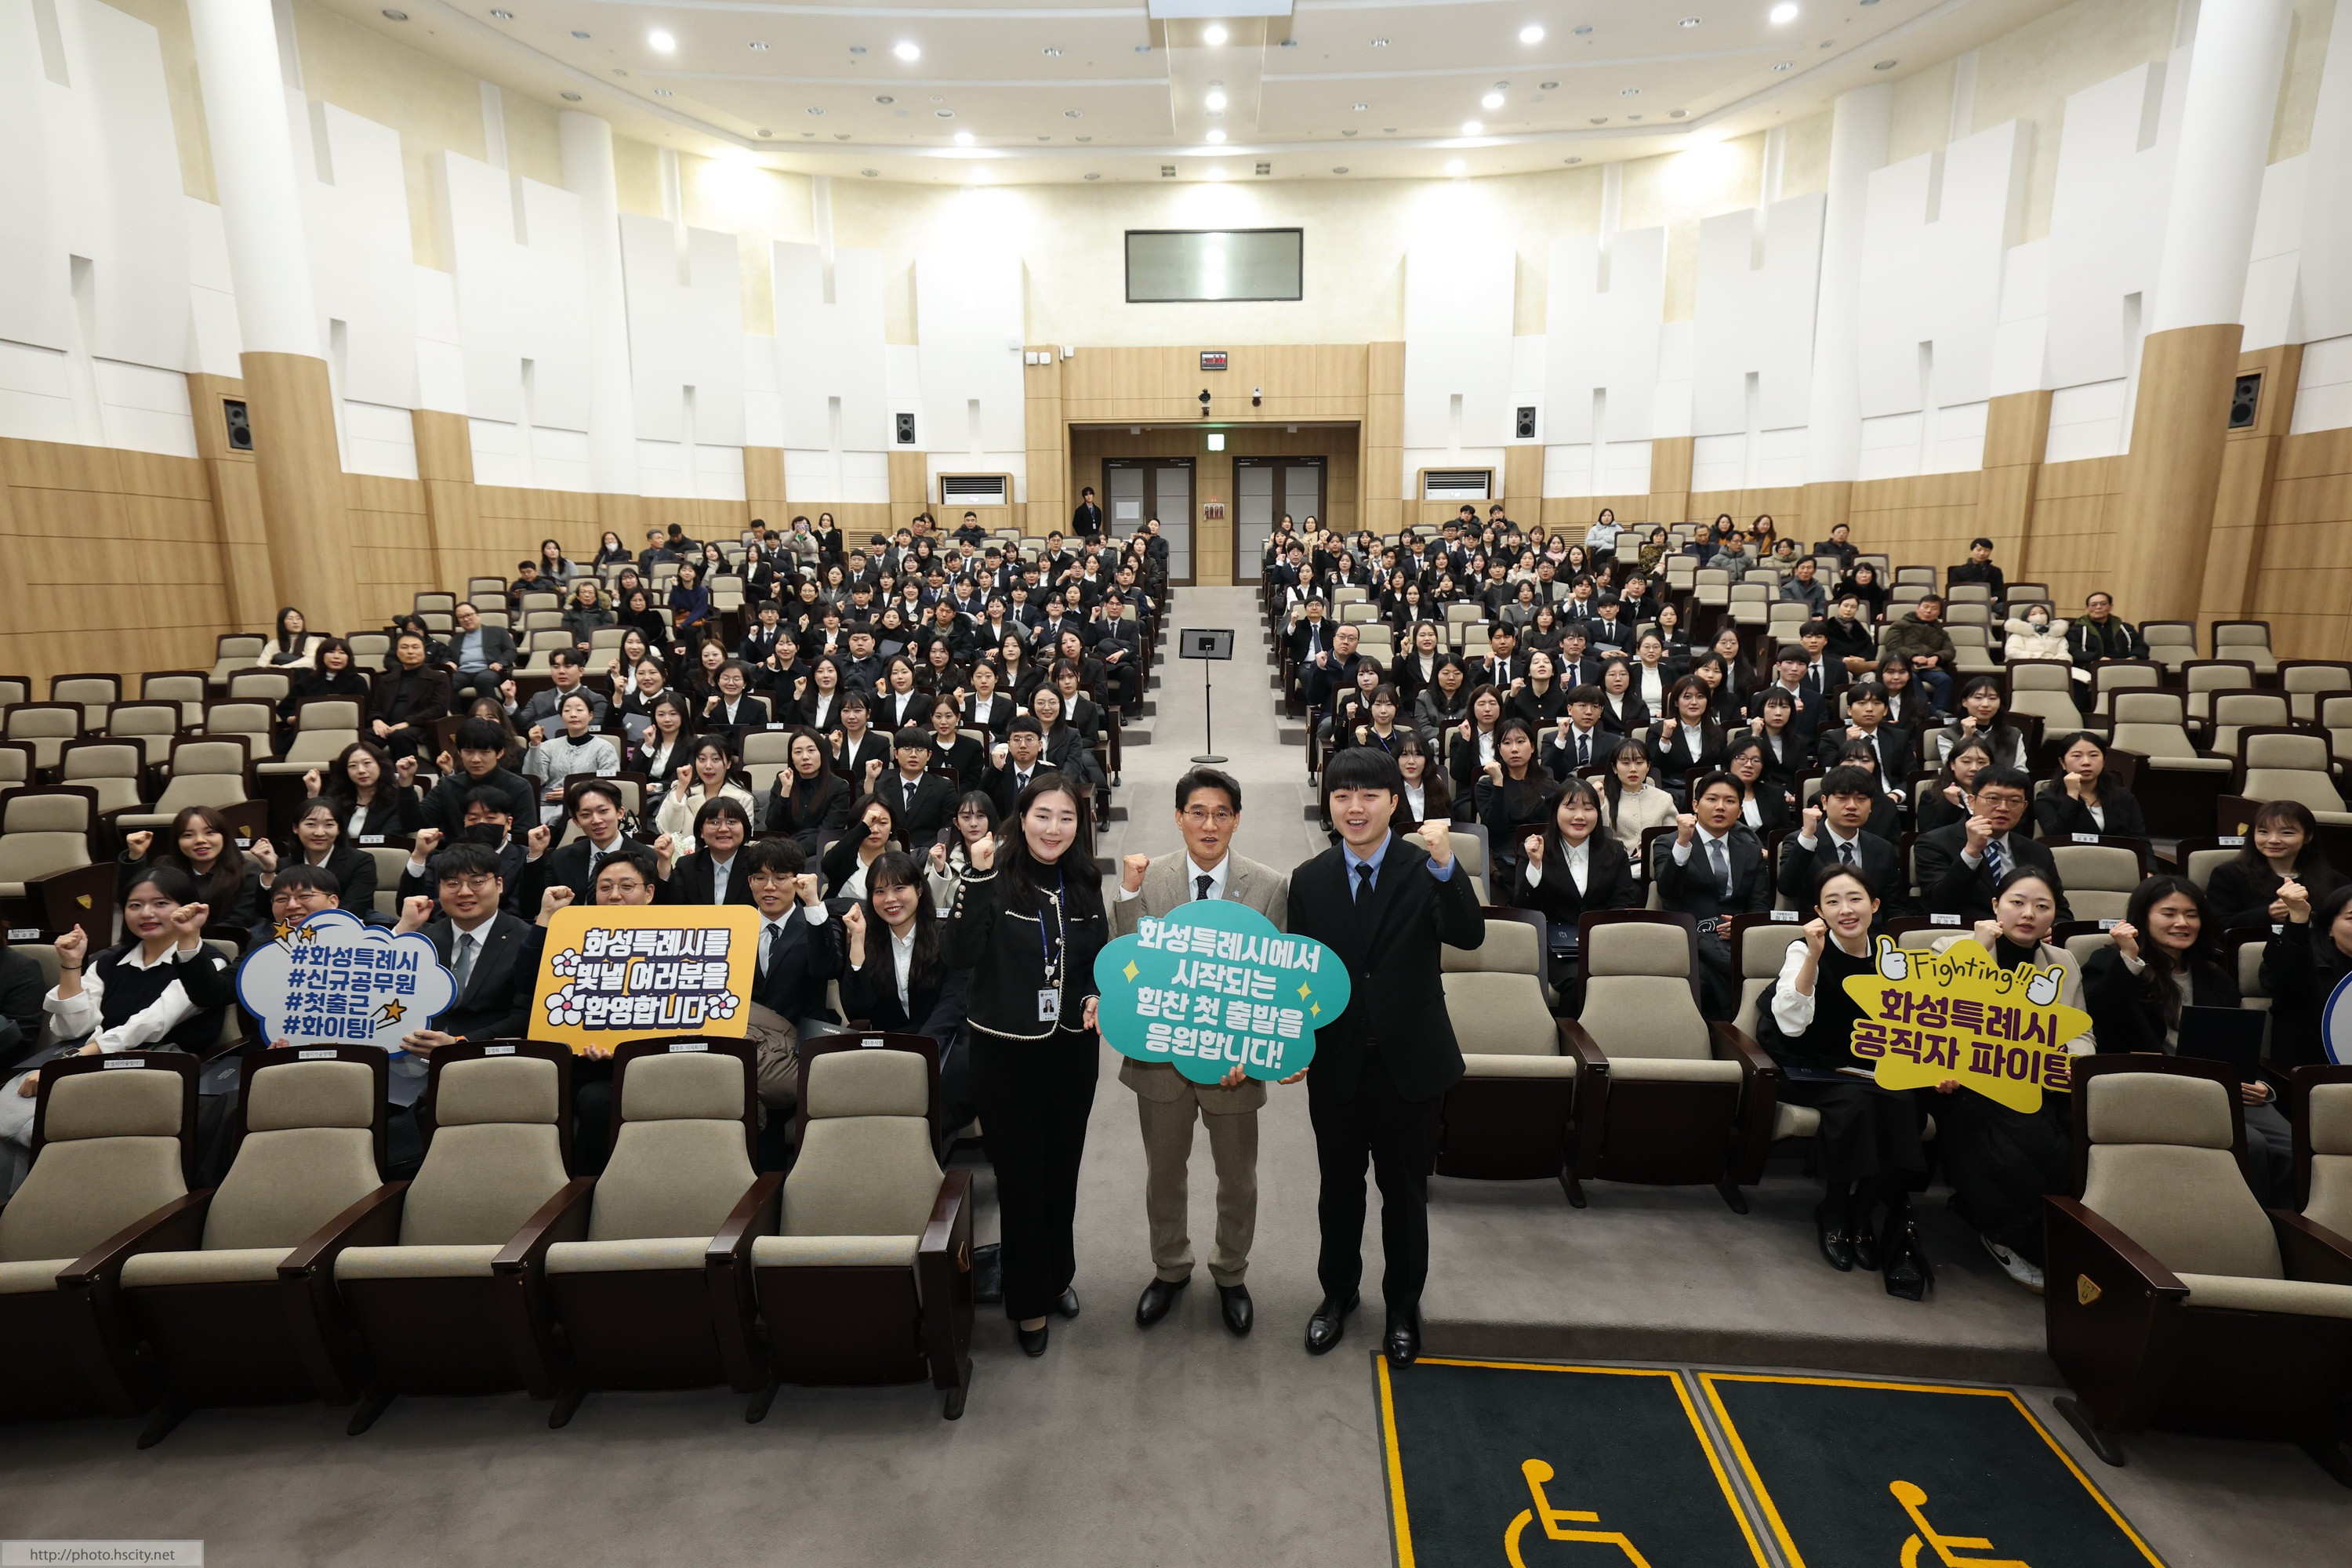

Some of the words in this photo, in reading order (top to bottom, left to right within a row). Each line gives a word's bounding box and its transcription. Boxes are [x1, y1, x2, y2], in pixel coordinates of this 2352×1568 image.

[290, 945, 419, 972] #화성특례시
[582, 927, 731, 960] 화성특례시를
[1137, 919, 1321, 974] 화성특례시에서
[287, 967, 417, 996] #신규공무원
[575, 961, 625, 992] 빛낼
[630, 961, 728, 991] 여러분을
[1171, 959, 1277, 1000] 시작되는
[1908, 951, 2034, 995] Fighting!!
[285, 991, 370, 1016] #첫출근
[583, 995, 710, 1026] 환영합니다
[1136, 986, 1191, 1021] 힘찬
[1192, 995, 1221, 1026] 첫
[1225, 1000, 1304, 1039] 출발을
[1879, 988, 2057, 1047] 화성특례시
[282, 1014, 376, 1040] #화이팅!
[1145, 1022, 1284, 1069] 응원합니다!
[1854, 1021, 1960, 1070] 공직자
